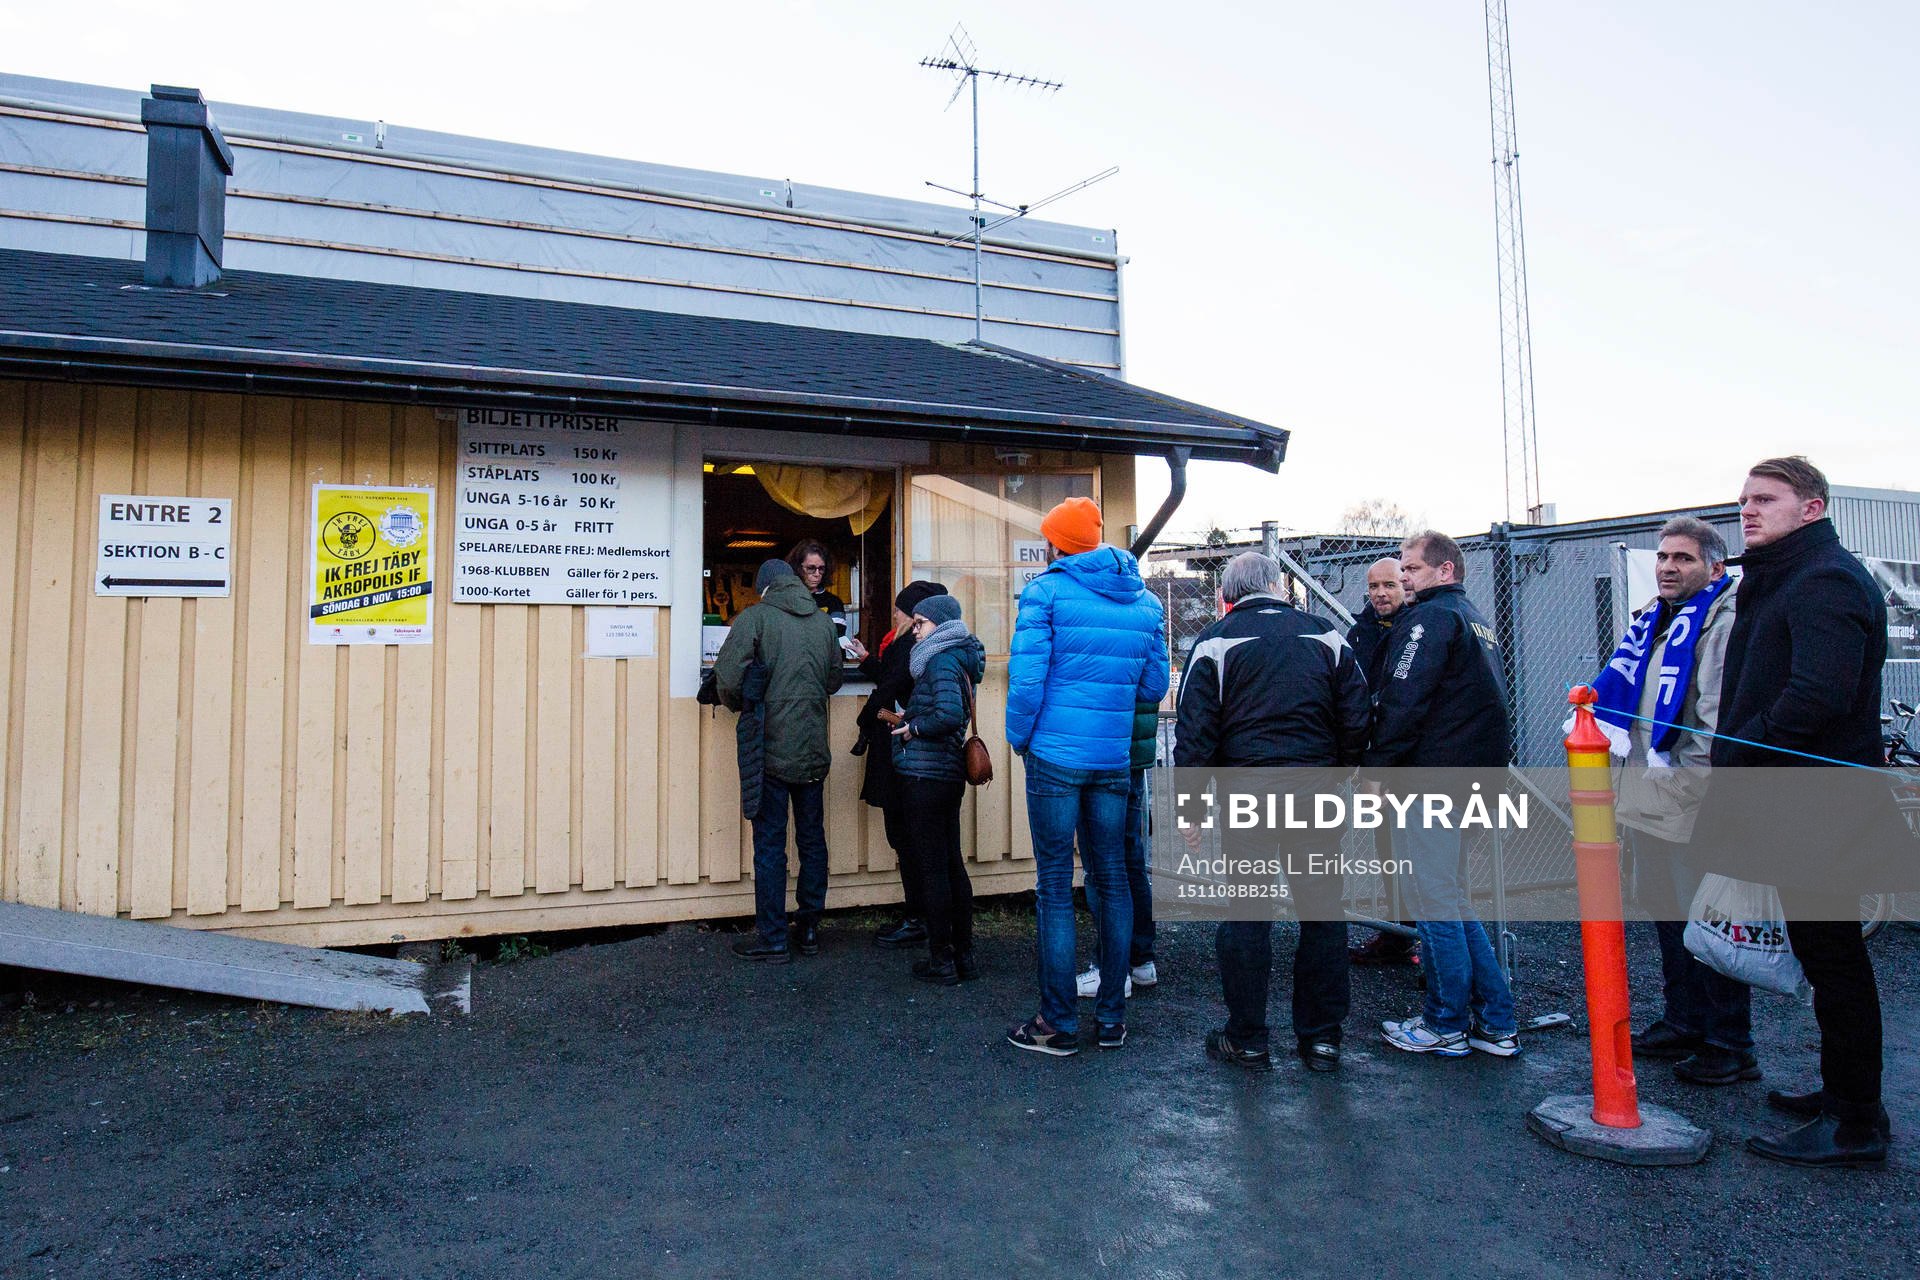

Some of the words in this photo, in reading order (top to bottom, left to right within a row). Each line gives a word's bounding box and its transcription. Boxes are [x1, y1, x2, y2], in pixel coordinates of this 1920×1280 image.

[467, 408, 619, 433] BILJETTPRISER
[469, 441, 545, 457] SITTPLATS
[573, 447, 598, 460] 150
[602, 448, 618, 461] Kr
[468, 464, 540, 482] STÅPLATS
[571, 472, 597, 484] 100
[600, 473, 616, 485] Kr
[466, 491, 511, 505] UNGA
[518, 494, 550, 506] 5-16
[553, 494, 568, 507] år
[579, 496, 597, 508] 50
[600, 497, 616, 509] Kr
[110, 503, 191, 523] ENTRE
[208, 506, 222, 524] 2
[465, 517, 509, 530] UNGA
[516, 519, 539, 531] 0-5
[543, 519, 557, 532] år
[574, 521, 614, 534] FRITT
[103, 544, 180, 559] SEKTION
[459, 541, 562, 555] SPELARE/LEDARE
[564, 545, 595, 556] FREJ:
[597, 546, 671, 558] Medlemskort
[1020, 548, 1047, 562] ENT
[325, 566, 341, 583] IK
[344, 559, 379, 579] FREJ
[382, 550, 421, 571] TÄBY
[461, 565, 550, 577] 1968-KLUBBEN
[567, 568, 601, 579] Gäller
[604, 568, 620, 579] för
[622, 570, 629, 579] 2
[631, 571, 659, 581] pers.
[323, 571, 403, 600] AKROPOLIS
[408, 567, 421, 582] IF
[322, 598, 360, 615] SÖNDAG
[363, 596, 370, 606] 8
[372, 592, 393, 605] NOV.
[396, 586, 422, 599] 15:00
[460, 586, 531, 597] 1000-Kortet
[565, 589, 600, 599] Gäller
[602, 589, 619, 599] för
[622, 590, 627, 599] 1
[630, 591, 658, 602] pers.
[1887, 624, 1915, 640] taurang
